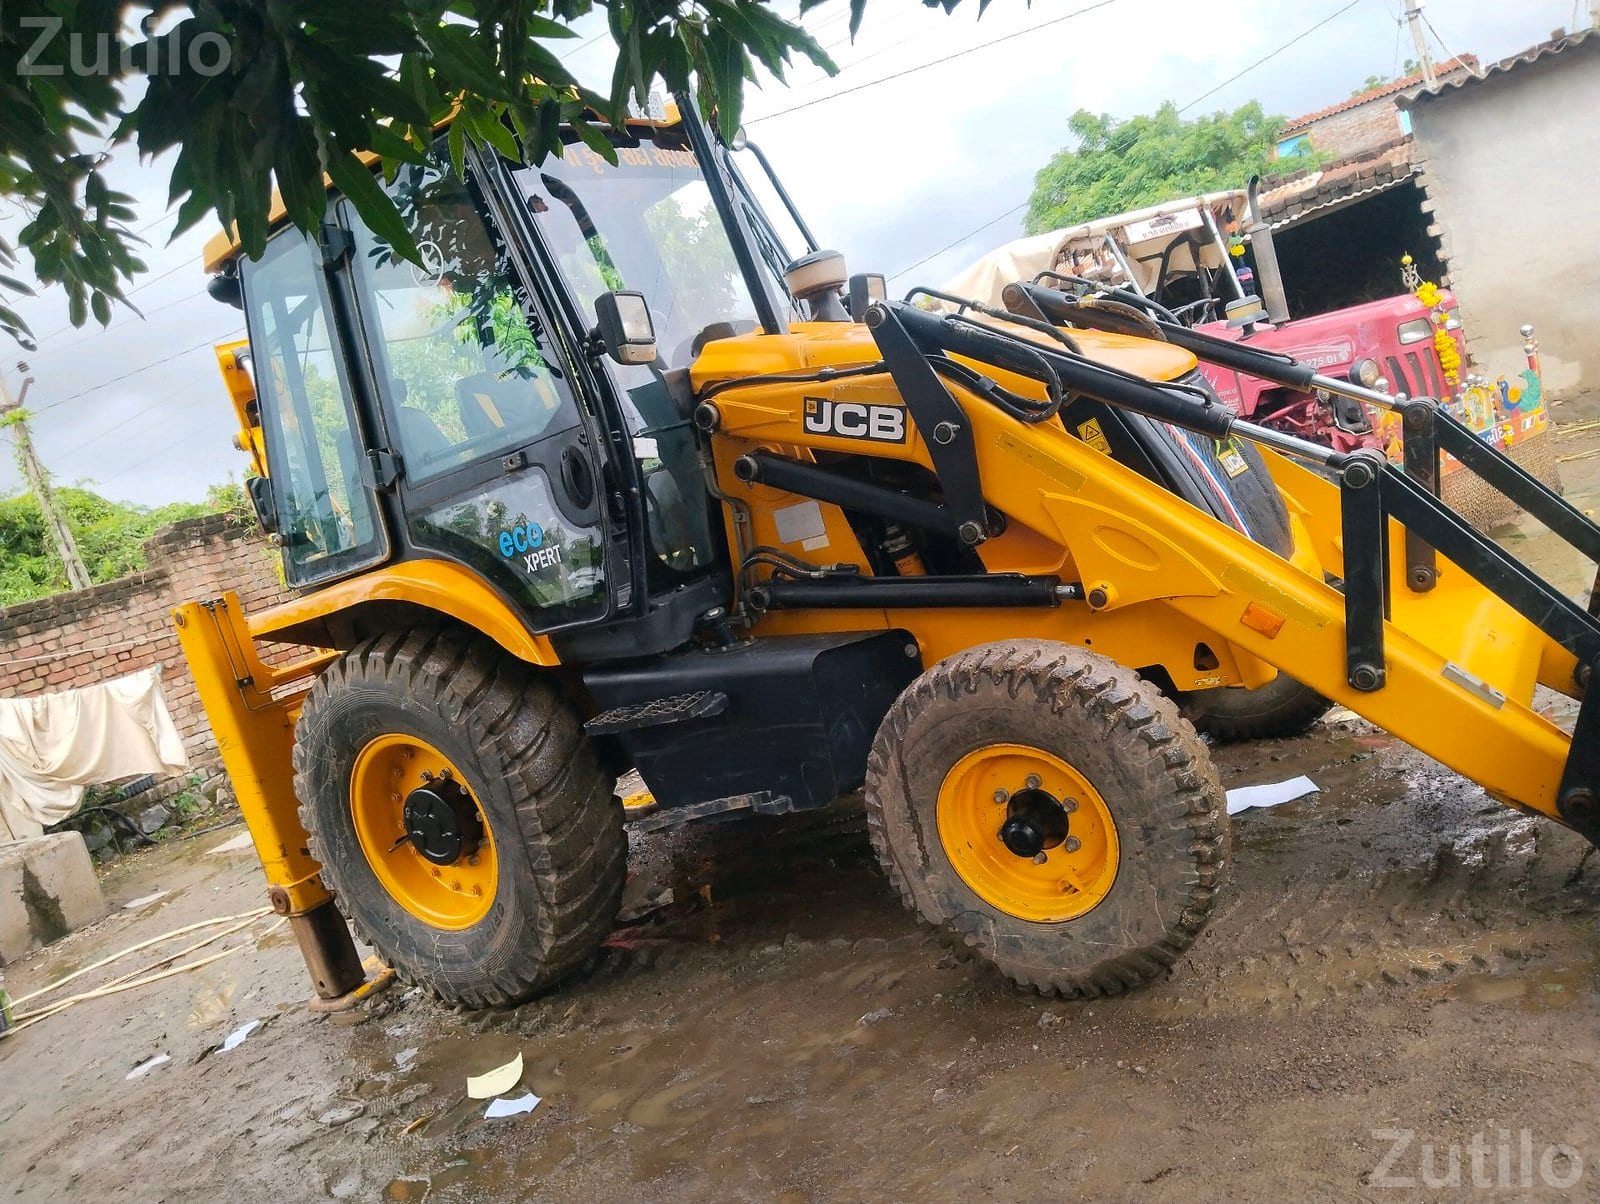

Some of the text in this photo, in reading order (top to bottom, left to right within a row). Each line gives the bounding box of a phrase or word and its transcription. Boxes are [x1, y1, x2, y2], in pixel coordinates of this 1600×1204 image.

[805, 401, 904, 440] JCB
[498, 521, 543, 558] eco
[523, 544, 562, 574] XPERT
